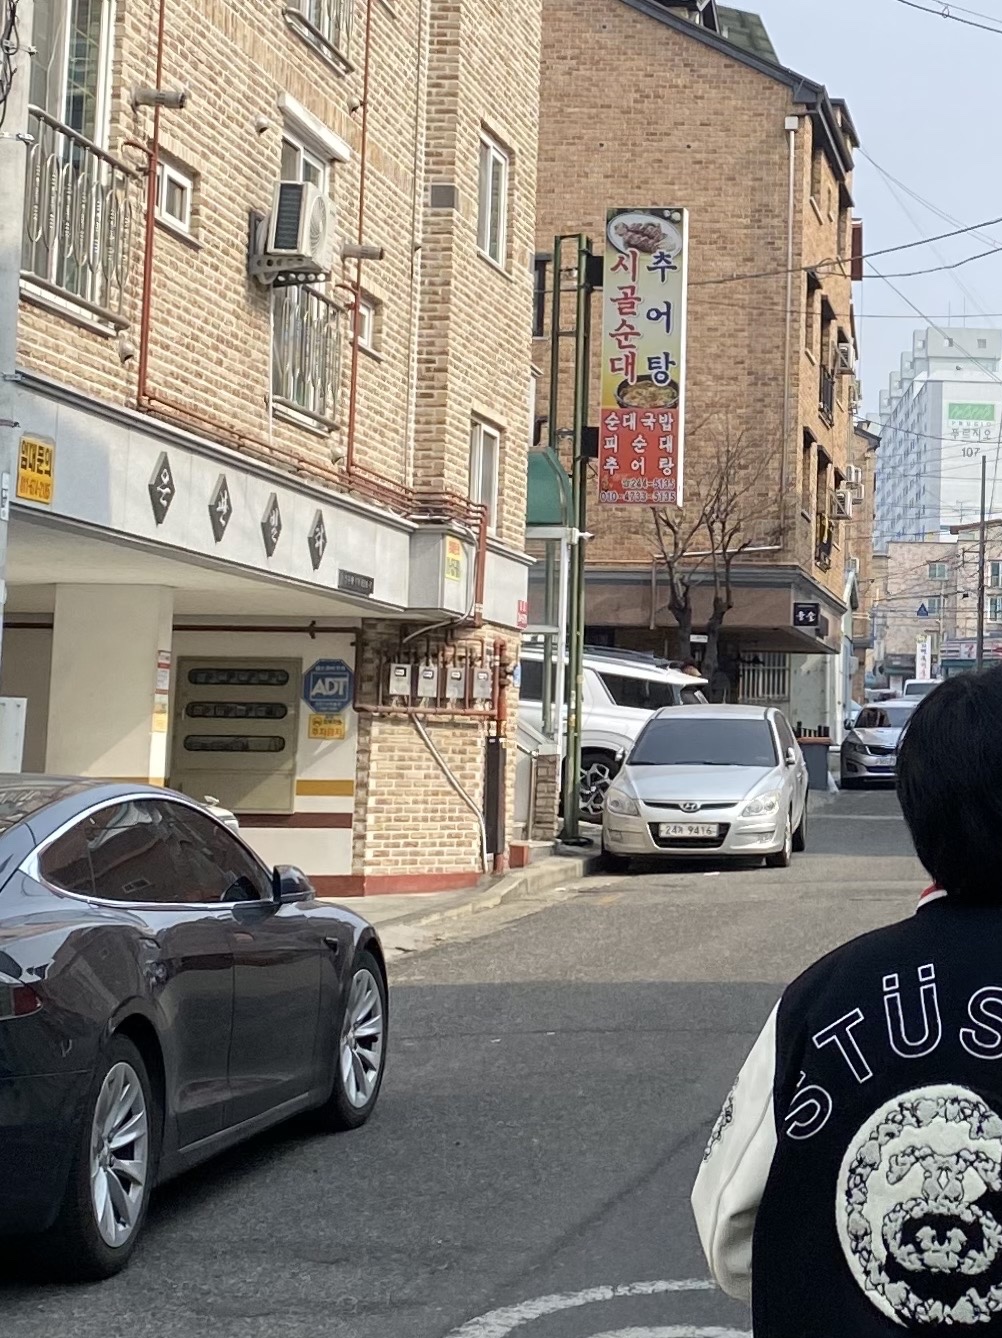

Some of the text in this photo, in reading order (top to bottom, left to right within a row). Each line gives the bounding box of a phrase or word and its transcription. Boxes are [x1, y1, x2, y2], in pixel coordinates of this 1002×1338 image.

[609, 250, 641, 383] 시골순대
[646, 252, 677, 384] 추어탕
[604, 411, 674, 432] 순대국밥
[603, 434, 673, 454] 피순대
[951, 427, 992, 441] 푸르지오
[21, 440, 53, 477] 임대문의
[961, 447, 981, 458] 107
[603, 456, 675, 476] 추어탕
[311, 677, 349, 696] ADT
